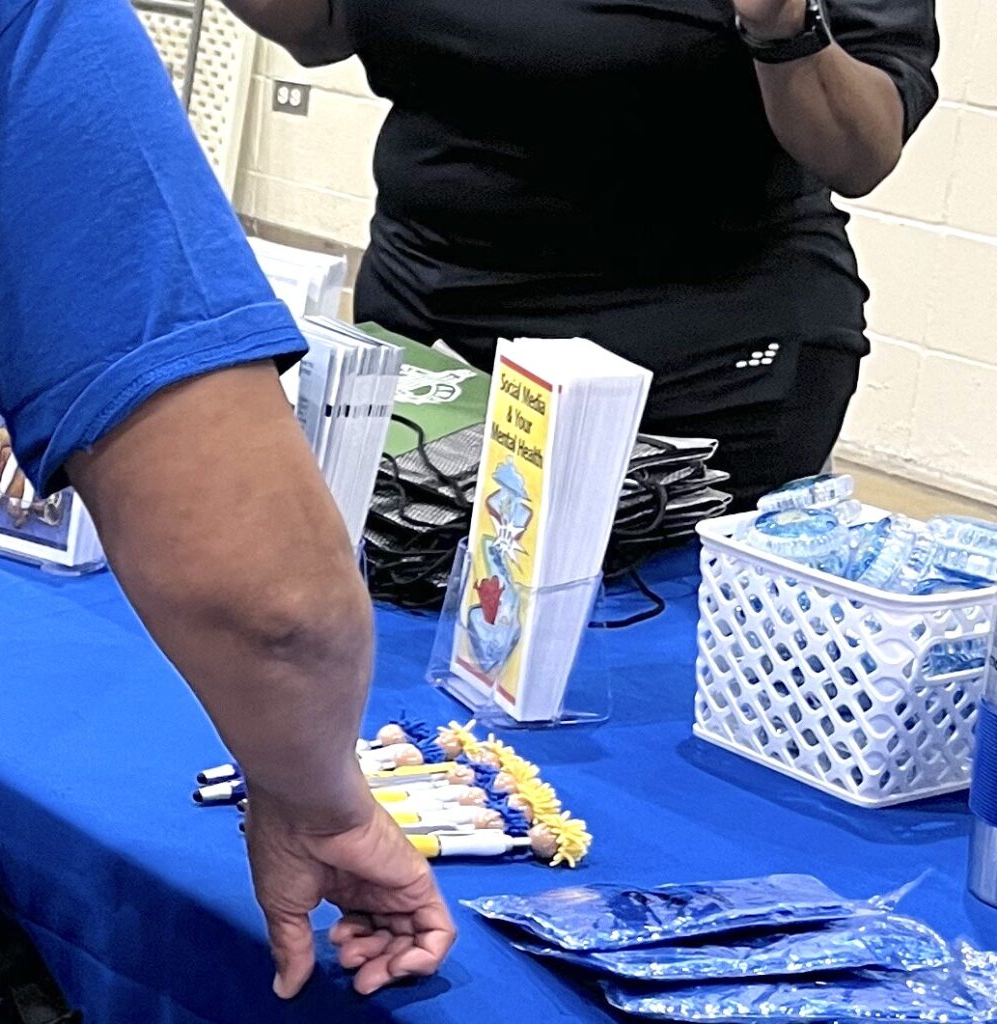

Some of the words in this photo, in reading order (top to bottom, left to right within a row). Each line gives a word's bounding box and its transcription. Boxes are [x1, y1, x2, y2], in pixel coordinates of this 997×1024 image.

[501, 373, 521, 400] Social
[522, 386, 545, 416] Media
[507, 405, 512, 423] &
[515, 409, 532, 434] Your
[492, 422, 517, 452] Mental
[518, 439, 543, 469] Health
